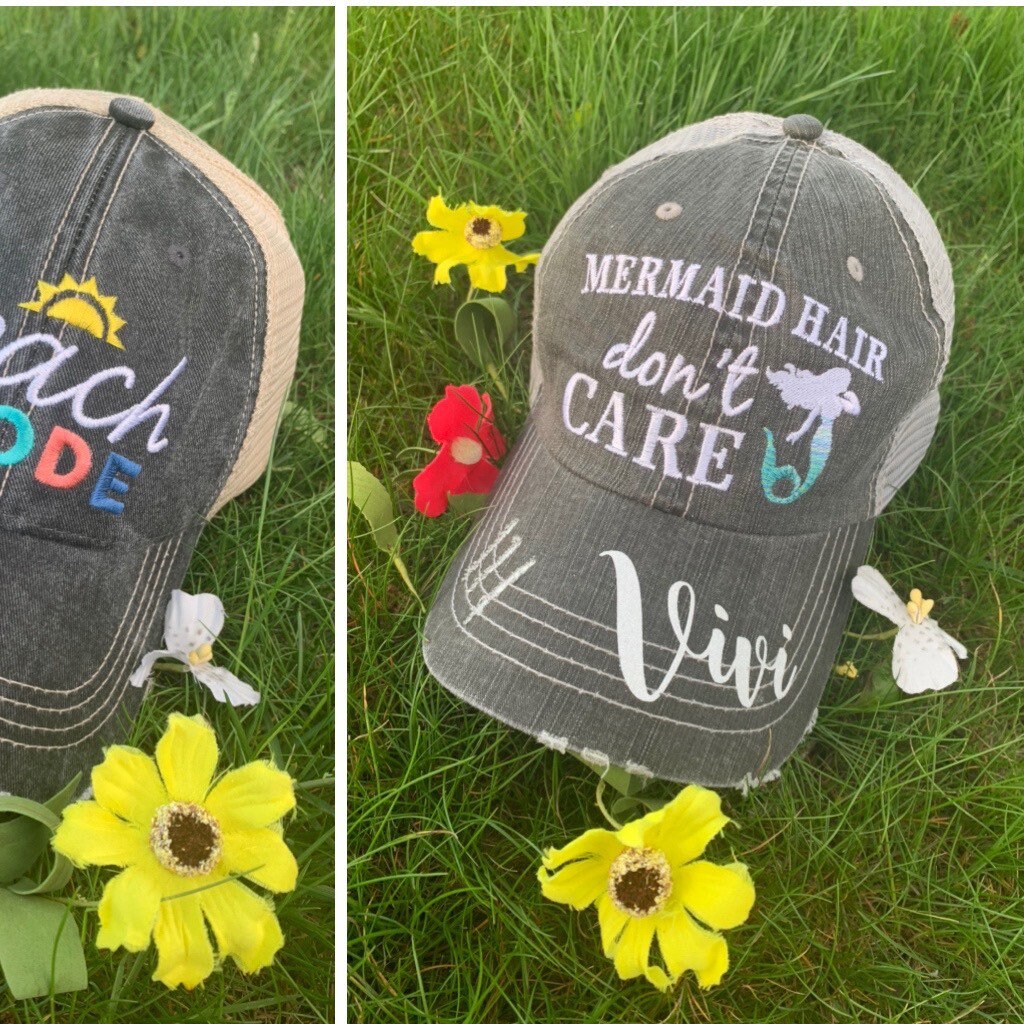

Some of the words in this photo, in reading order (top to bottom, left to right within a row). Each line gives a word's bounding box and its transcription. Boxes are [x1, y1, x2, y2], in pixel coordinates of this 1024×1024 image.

[580, 253, 786, 327] MERMAID
[791, 295, 888, 383] HAIR
[602, 311, 759, 417] don't
[561, 372, 746, 492] CARE
[599, 549, 797, 707] Vivi
